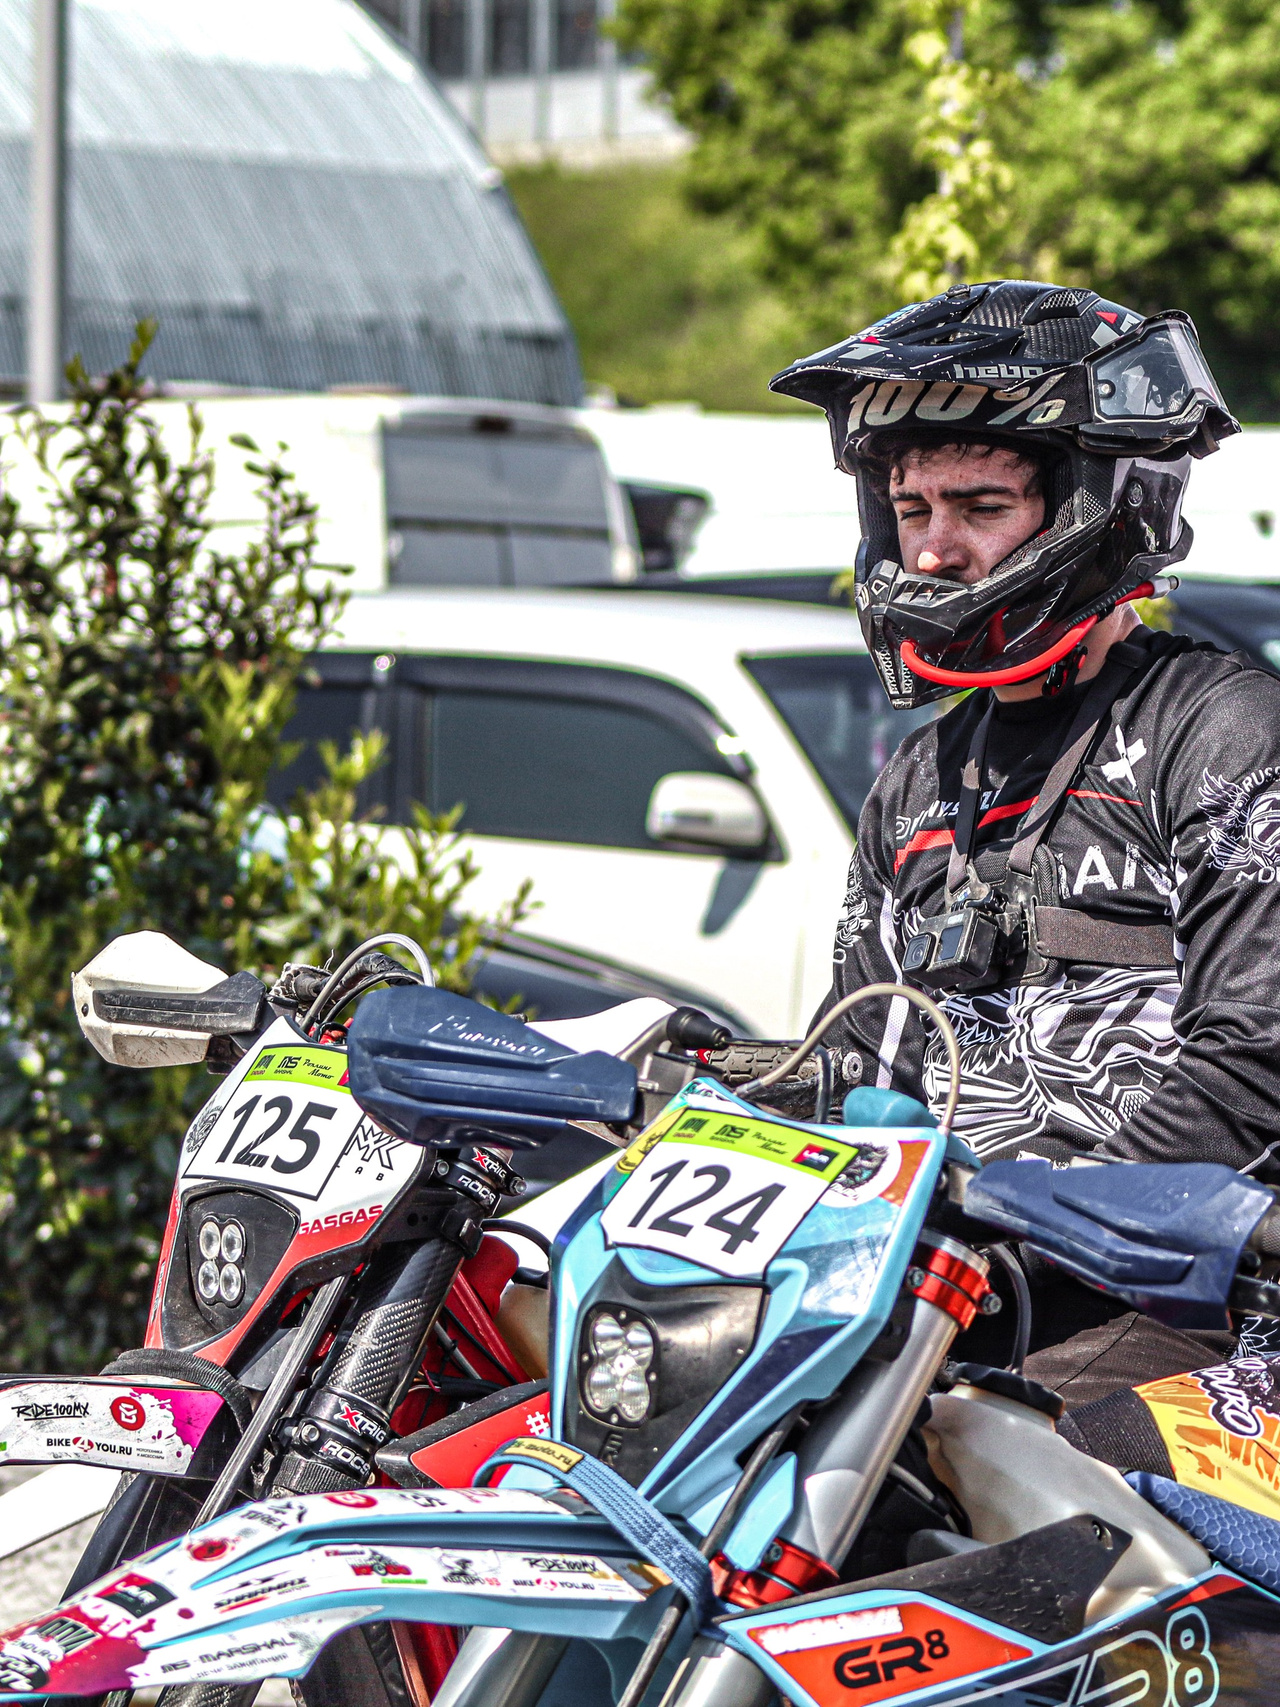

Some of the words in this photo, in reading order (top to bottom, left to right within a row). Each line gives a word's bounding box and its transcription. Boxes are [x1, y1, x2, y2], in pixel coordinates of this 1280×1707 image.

[953, 363, 1044, 379] hebo
[846, 372, 1067, 434] 100%
[215, 1095, 338, 1175] 125
[471, 1150, 507, 1179] XTRIG
[298, 1205, 384, 1236] GASGAS
[625, 1159, 787, 1255] 124
[334, 1399, 387, 1443] XTRIG
[319, 1440, 371, 1476] ROCS
[199, 1637, 296, 1664] MARSHAL
[834, 1628, 950, 1689] GR8
